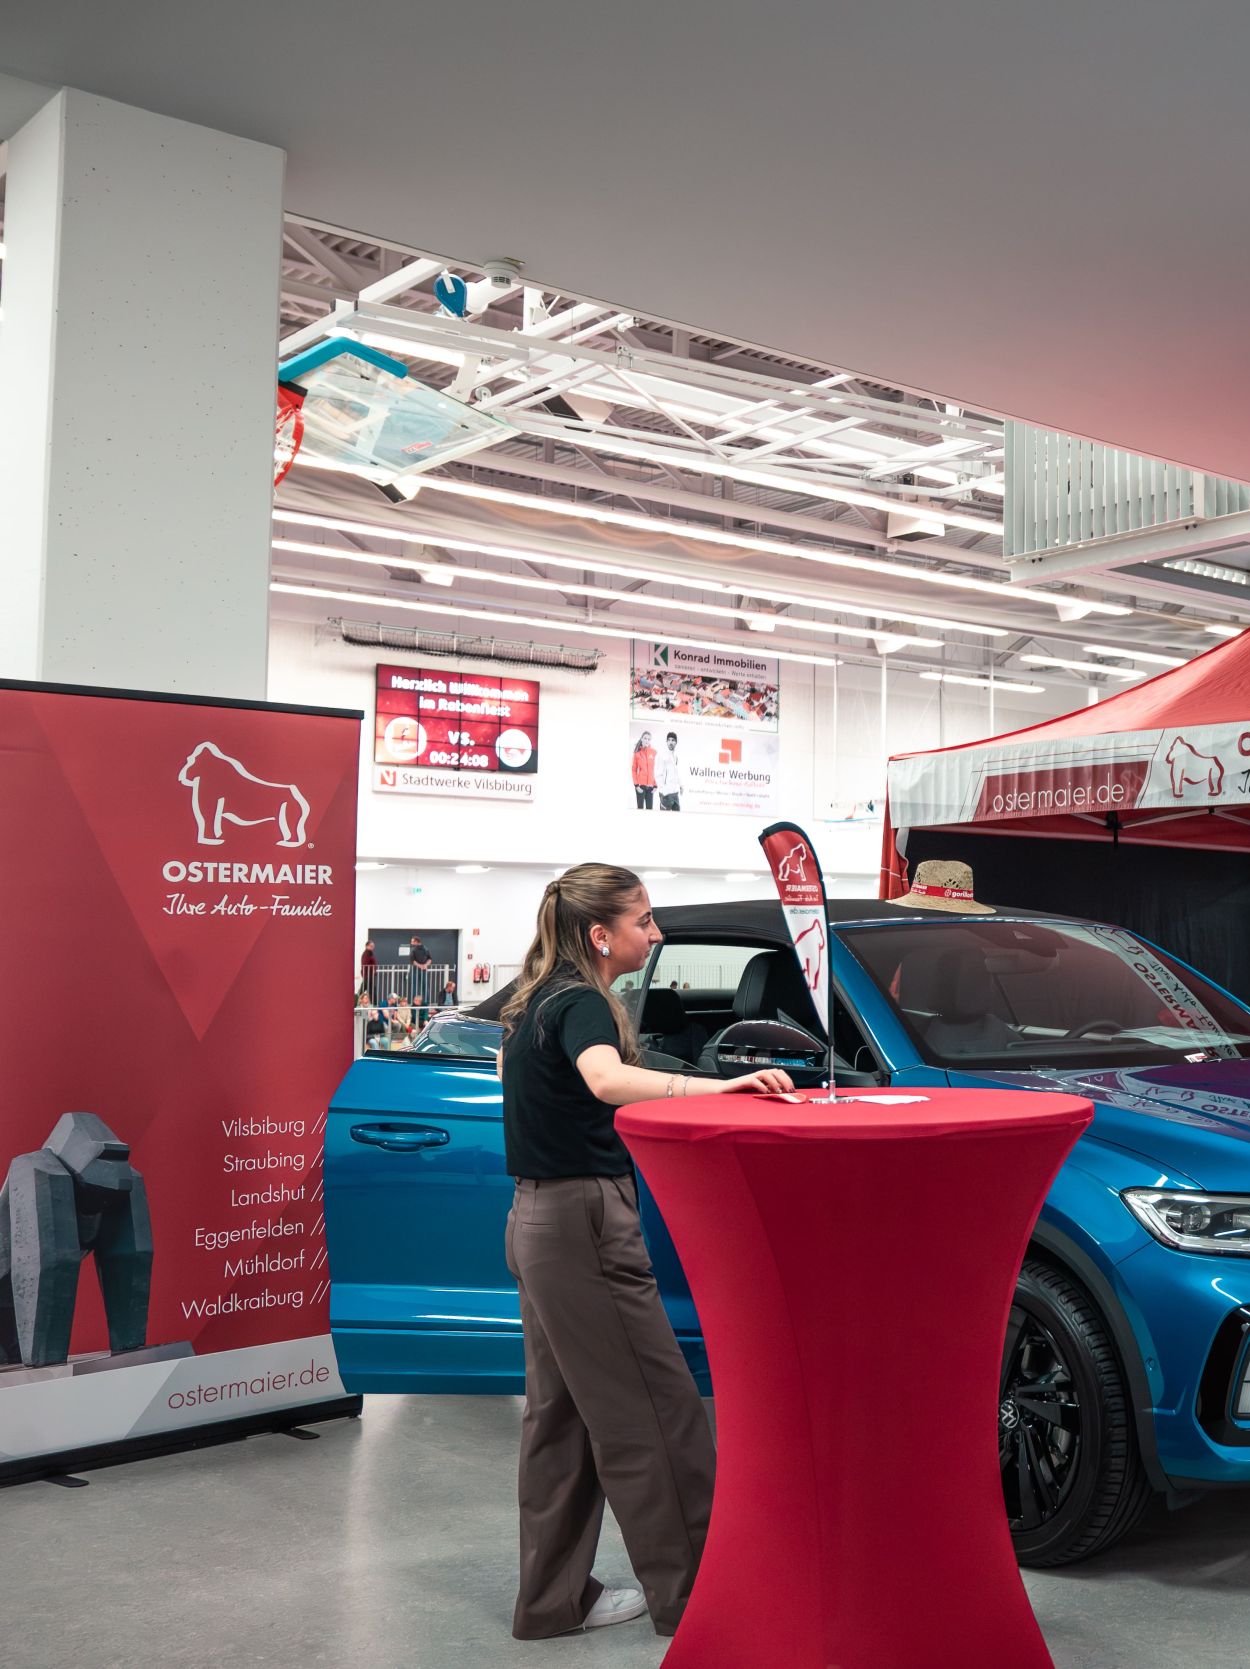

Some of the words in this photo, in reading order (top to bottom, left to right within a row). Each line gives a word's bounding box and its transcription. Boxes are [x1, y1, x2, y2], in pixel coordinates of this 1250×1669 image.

[673, 649, 711, 665] Konrad
[713, 655, 767, 672] Immobilien
[391, 674, 447, 693] Herzlich
[402, 774, 471, 788] Stadtwerke
[474, 777, 533, 796] Vilsbiburg
[689, 766, 726, 779] Wallner
[729, 770, 771, 785] Werbung
[993, 772, 1124, 812] ostermaier.de
[162, 860, 333, 885] OSTERMAIER
[162, 893, 207, 915] Ihre
[210, 894, 333, 917] Auto-Familie
[222, 1116, 305, 1137] Vilsbiburg
[223, 1150, 305, 1173] Straubing
[231, 1182, 306, 1207] Landshut
[195, 1217, 304, 1250] Eggenfelden
[224, 1248, 305, 1278] Mühldorf
[181, 1288, 304, 1319] Waldkraiburg
[168, 1359, 330, 1409] ostermaier.de
